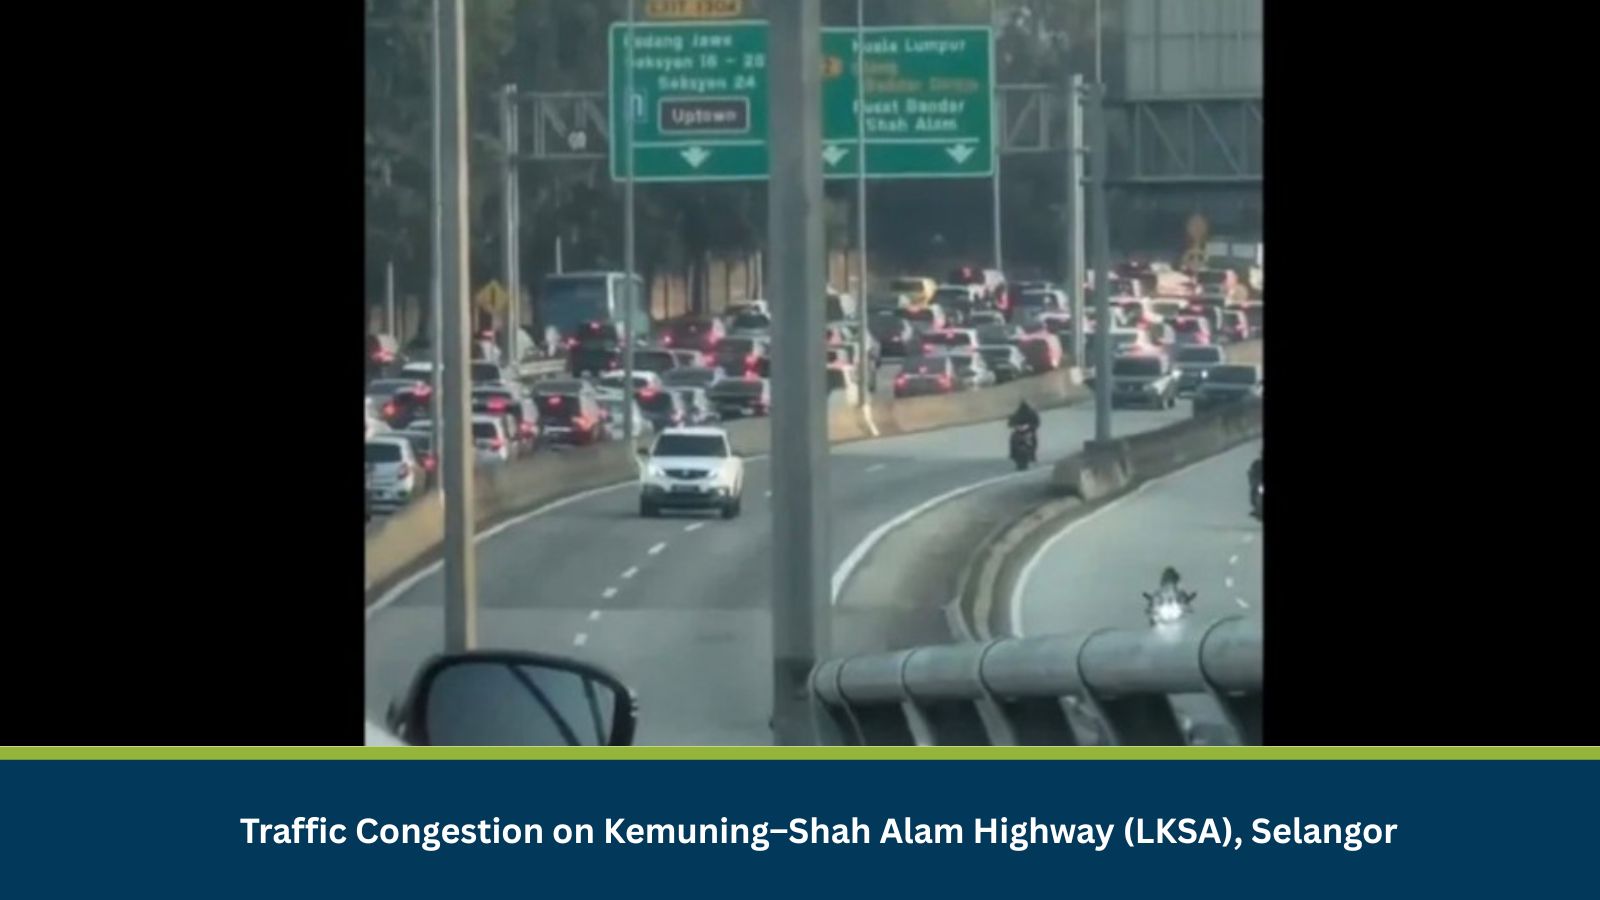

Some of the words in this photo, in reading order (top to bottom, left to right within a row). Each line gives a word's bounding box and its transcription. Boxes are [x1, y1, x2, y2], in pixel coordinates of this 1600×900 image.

[905, 38, 966, 55] Lumpur
[658, 76, 727, 93] Seksyen
[907, 98, 966, 113] Bandar
[671, 108, 737, 125] Uptown
[865, 117, 909, 132] Shah
[916, 117, 958, 131] Alam
